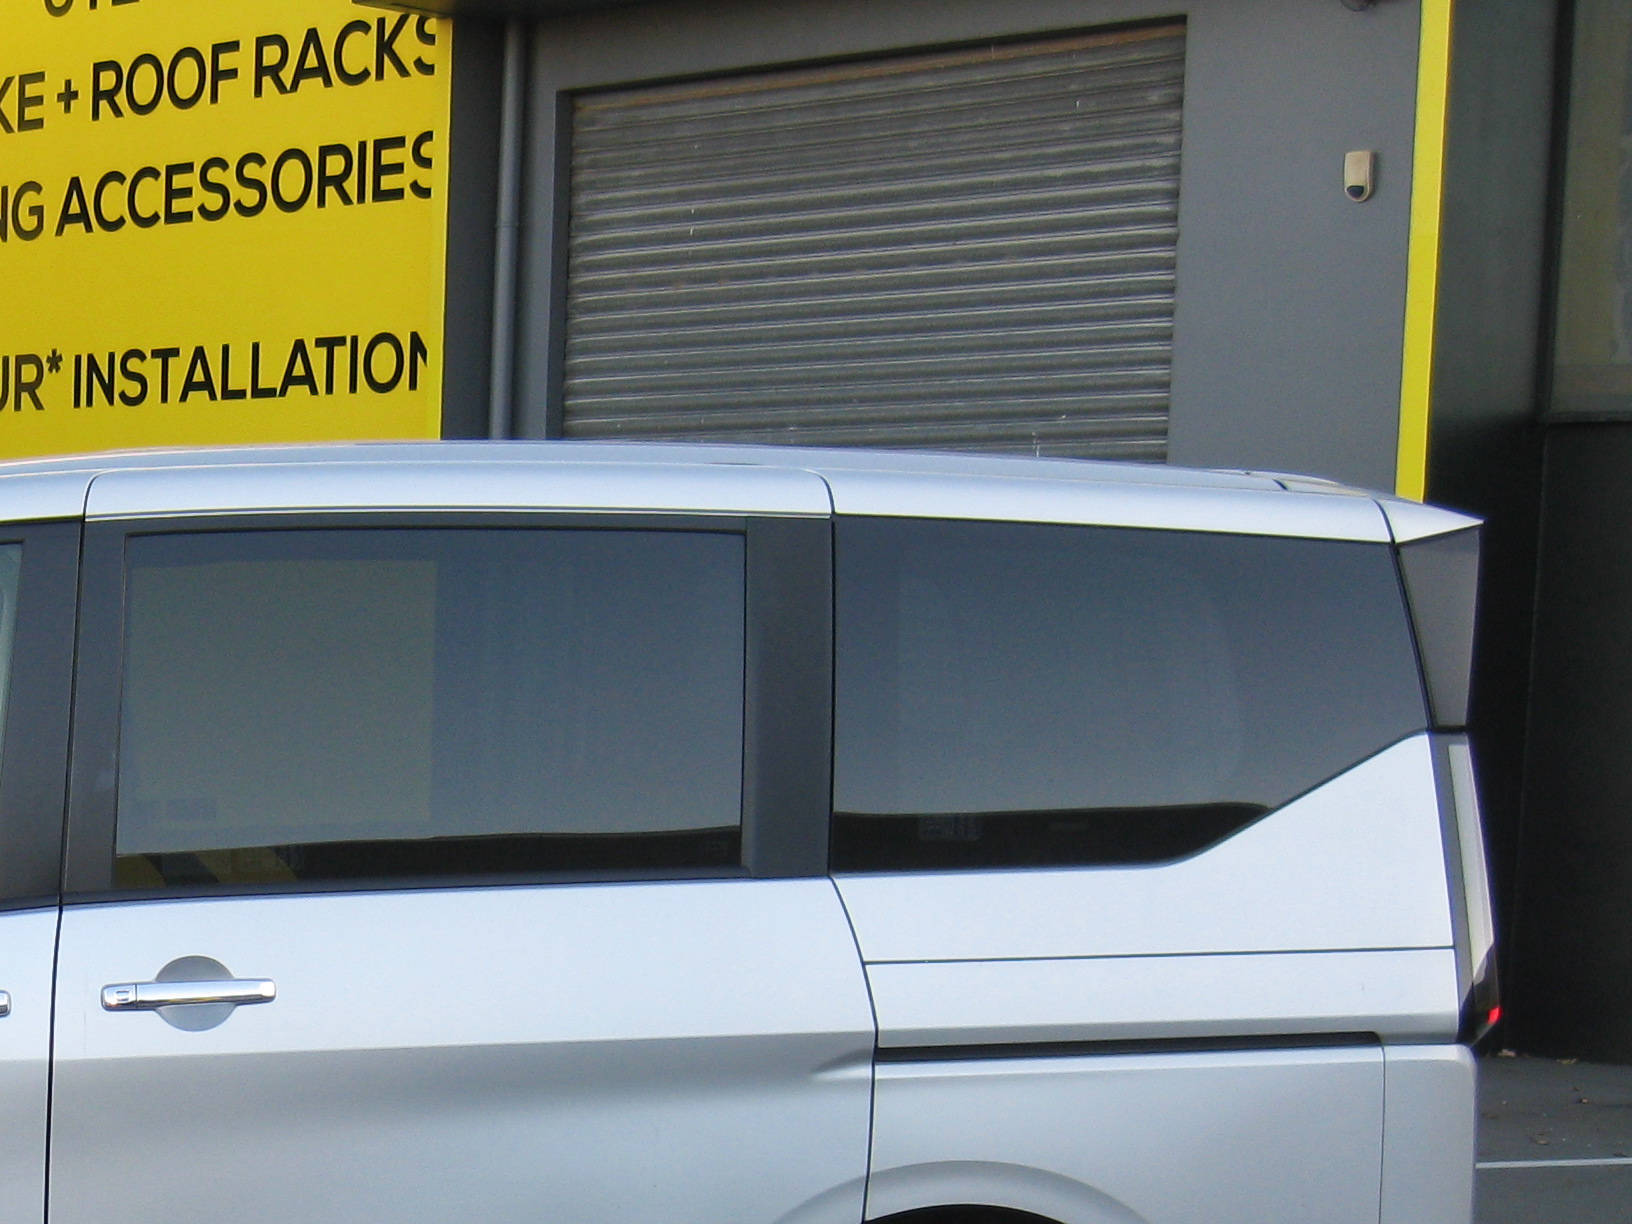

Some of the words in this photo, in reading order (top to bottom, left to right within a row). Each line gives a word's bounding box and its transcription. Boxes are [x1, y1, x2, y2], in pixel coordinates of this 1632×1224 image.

[56, 79, 79, 114] +
[91, 40, 241, 121] ROOF
[55, 130, 434, 236] ACCESSORIES
